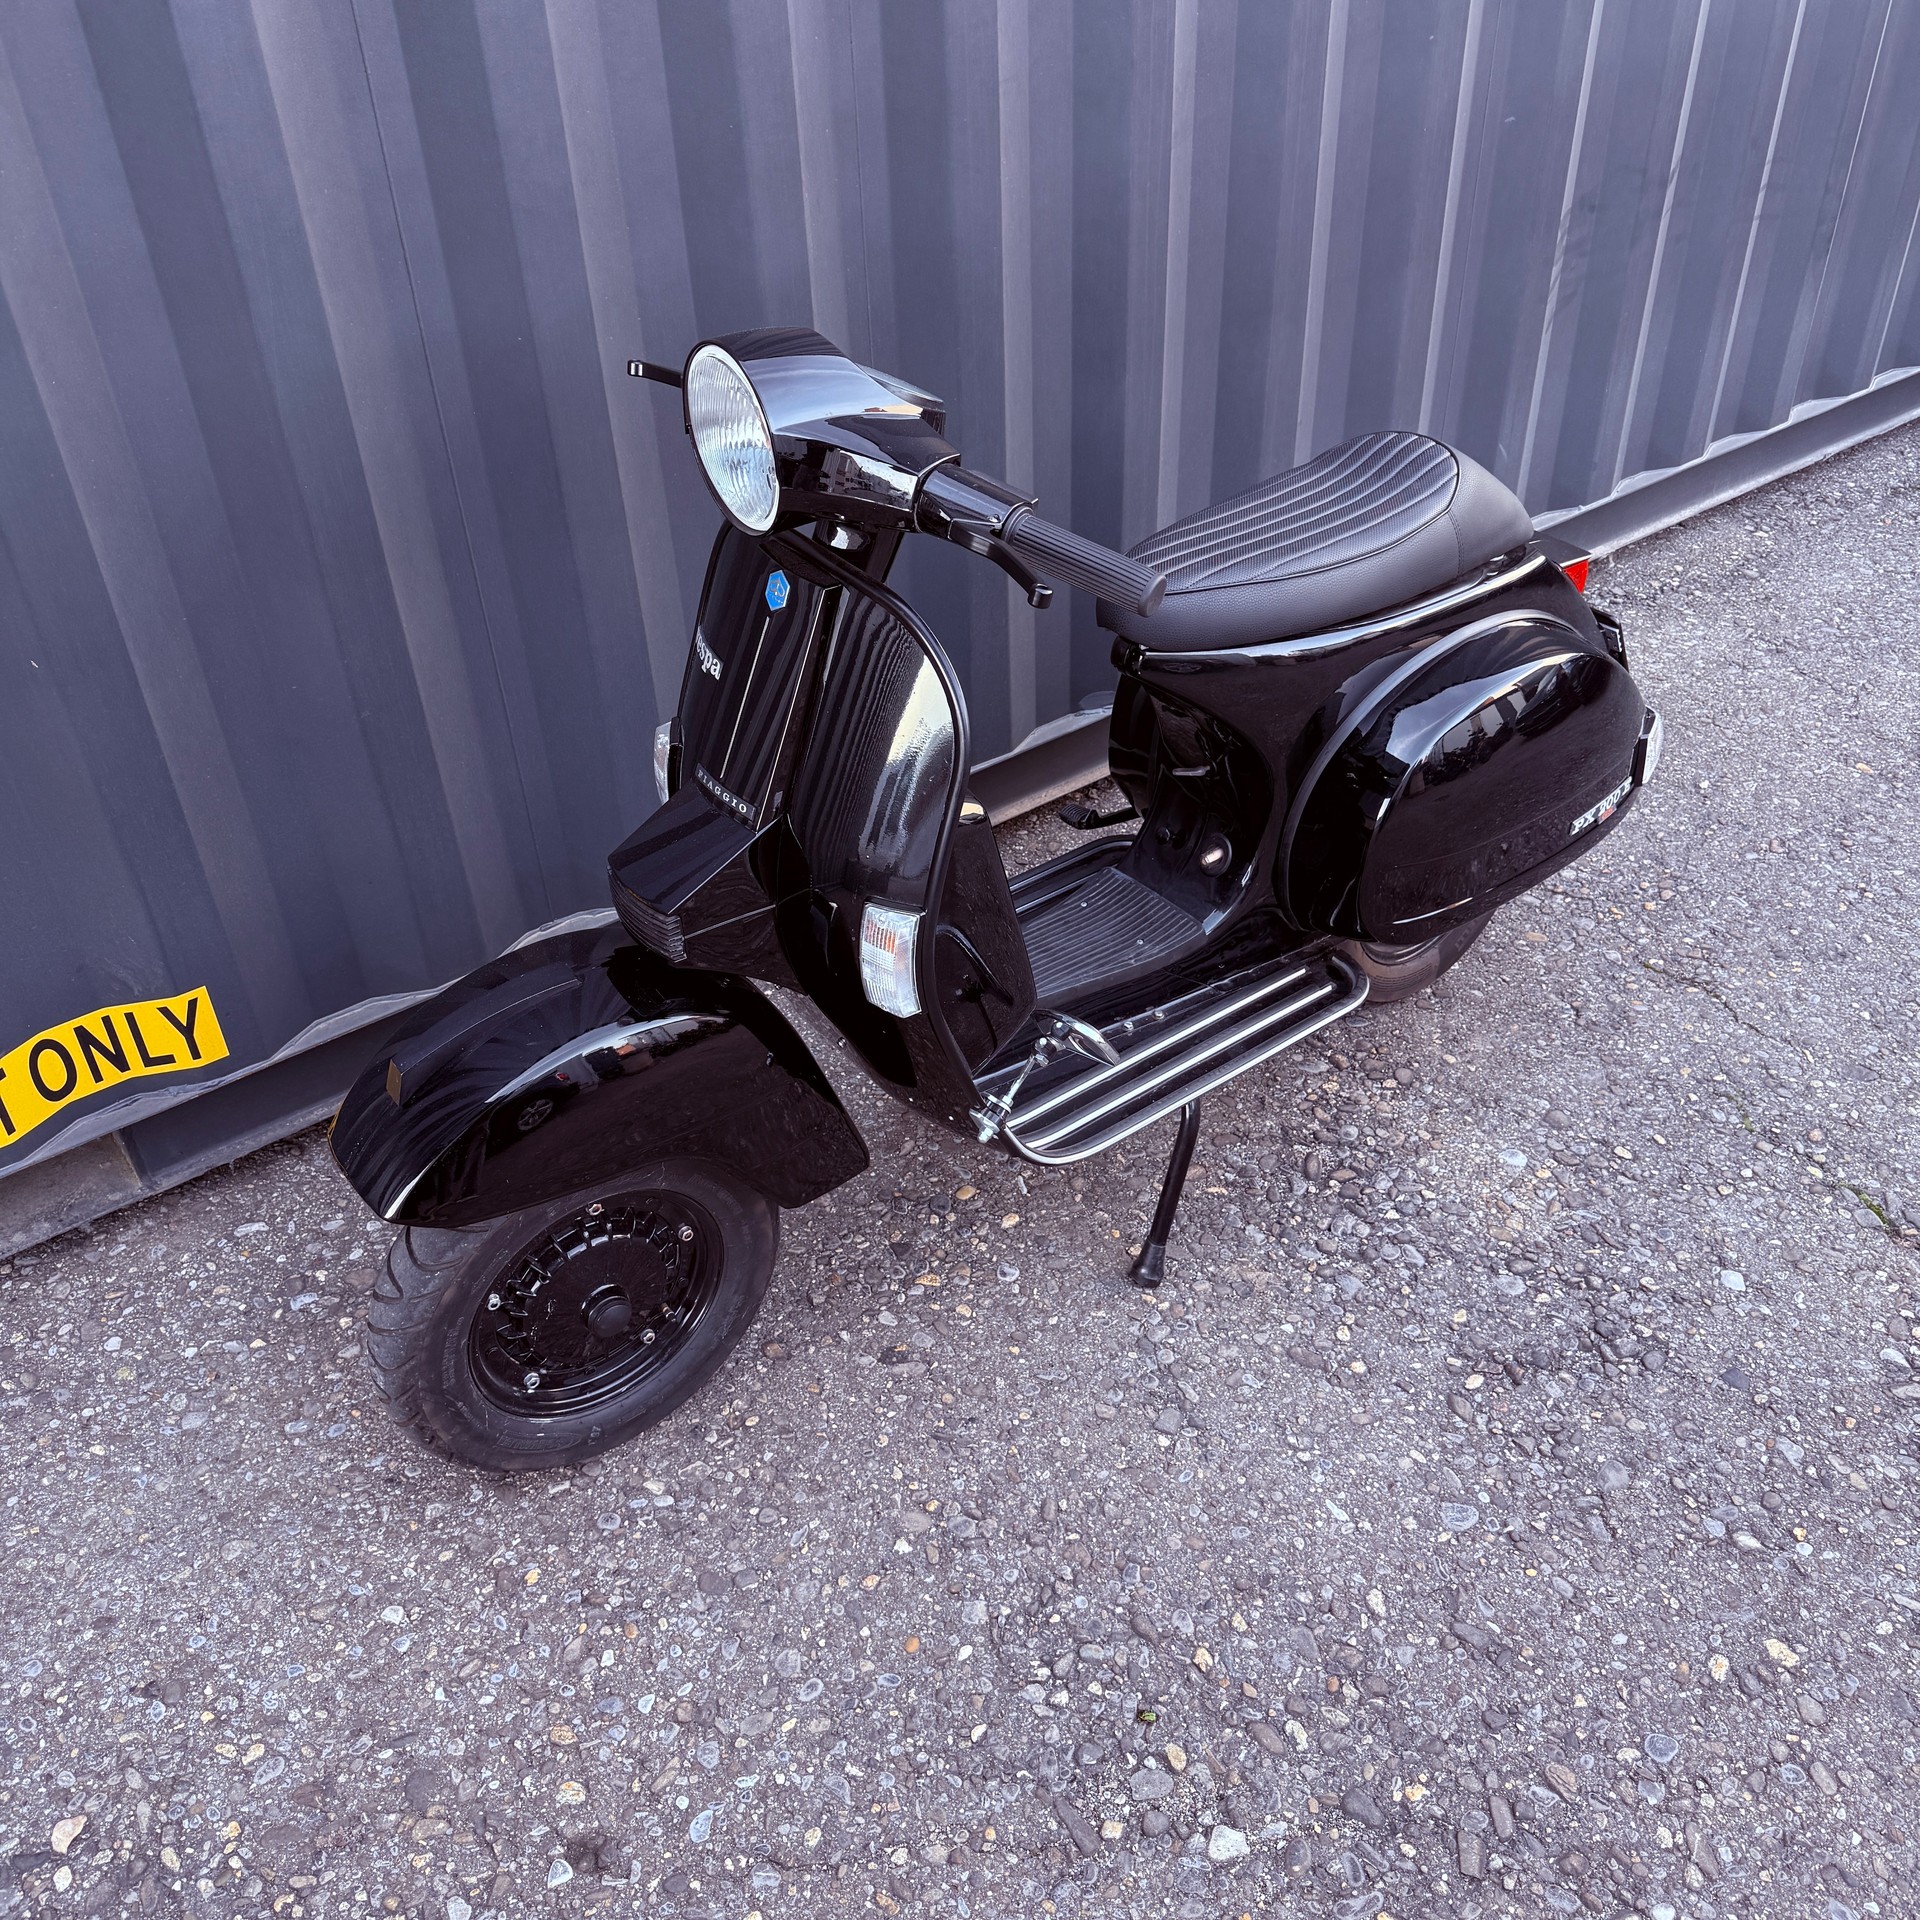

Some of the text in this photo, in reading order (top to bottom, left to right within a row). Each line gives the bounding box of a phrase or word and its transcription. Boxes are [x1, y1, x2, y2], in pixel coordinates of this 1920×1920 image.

[697, 769, 747, 813] PIAGGIO
[1570, 807, 1597, 836] PX
[28, 997, 202, 1102] ONLY
